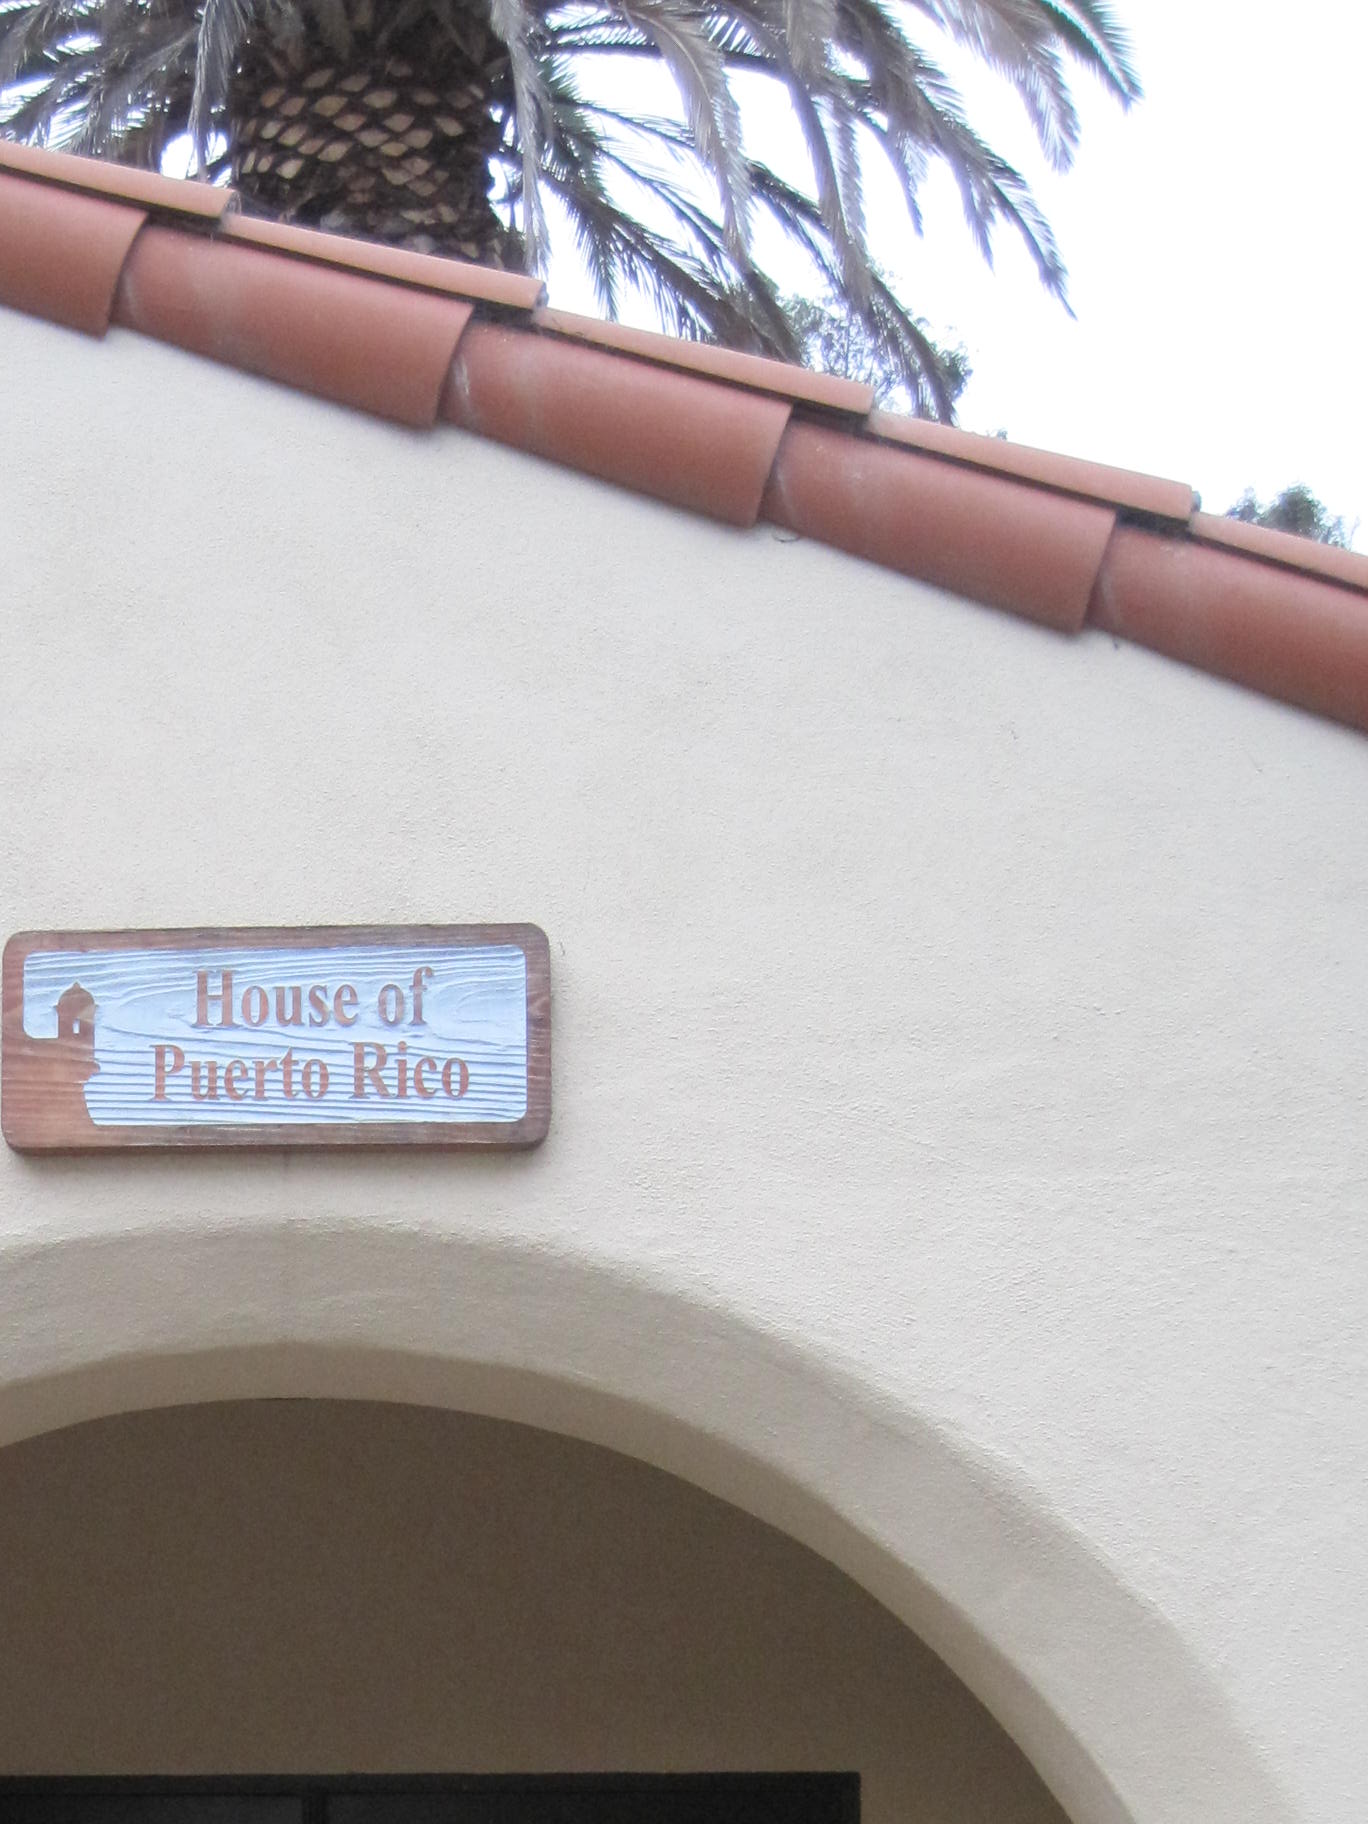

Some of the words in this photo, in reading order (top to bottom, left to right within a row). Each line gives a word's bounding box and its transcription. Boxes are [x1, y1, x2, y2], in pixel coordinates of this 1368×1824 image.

[191, 969, 359, 1028] House
[377, 966, 434, 1027] of
[148, 1043, 331, 1102] Puerto
[349, 1040, 471, 1101] Rico
